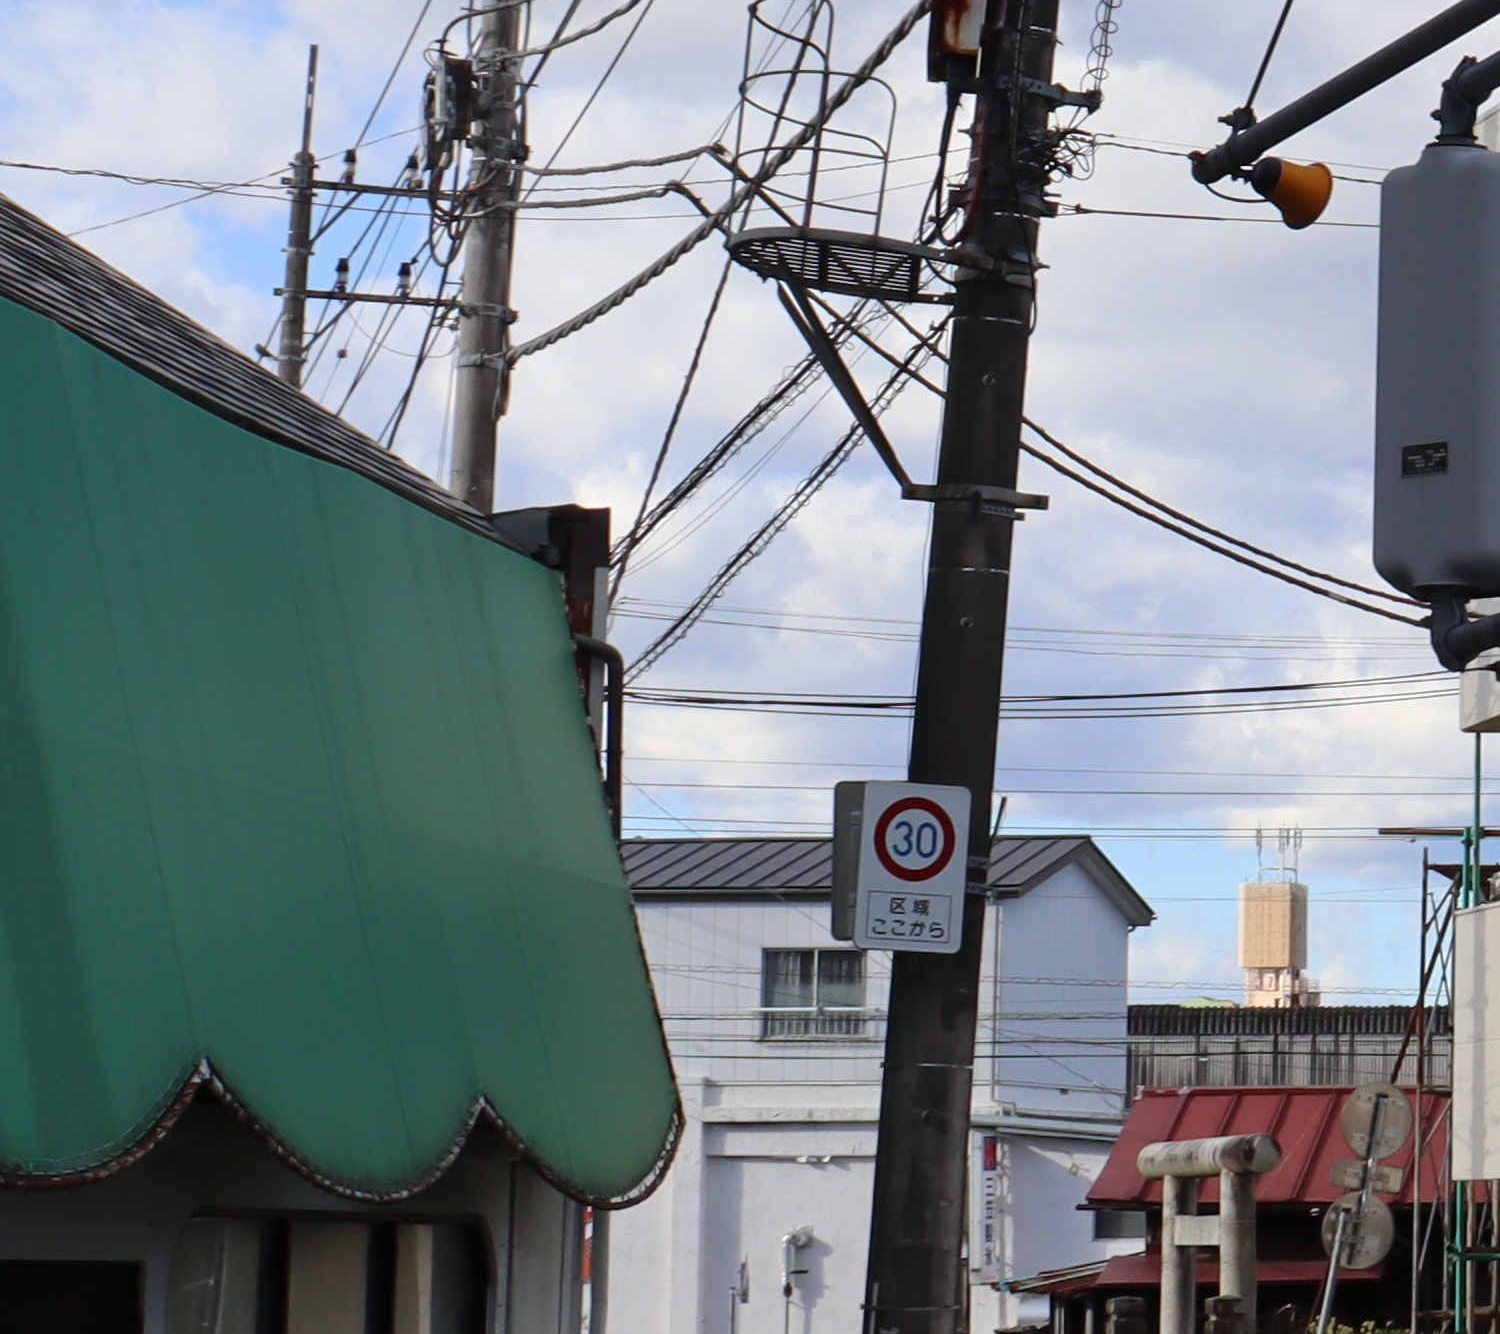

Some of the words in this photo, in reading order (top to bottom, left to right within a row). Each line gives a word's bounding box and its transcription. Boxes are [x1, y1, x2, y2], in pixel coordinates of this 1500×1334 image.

[892, 820, 937, 858] 30
[889, 897, 930, 916] 区域
[871, 917, 945, 939] ここから
